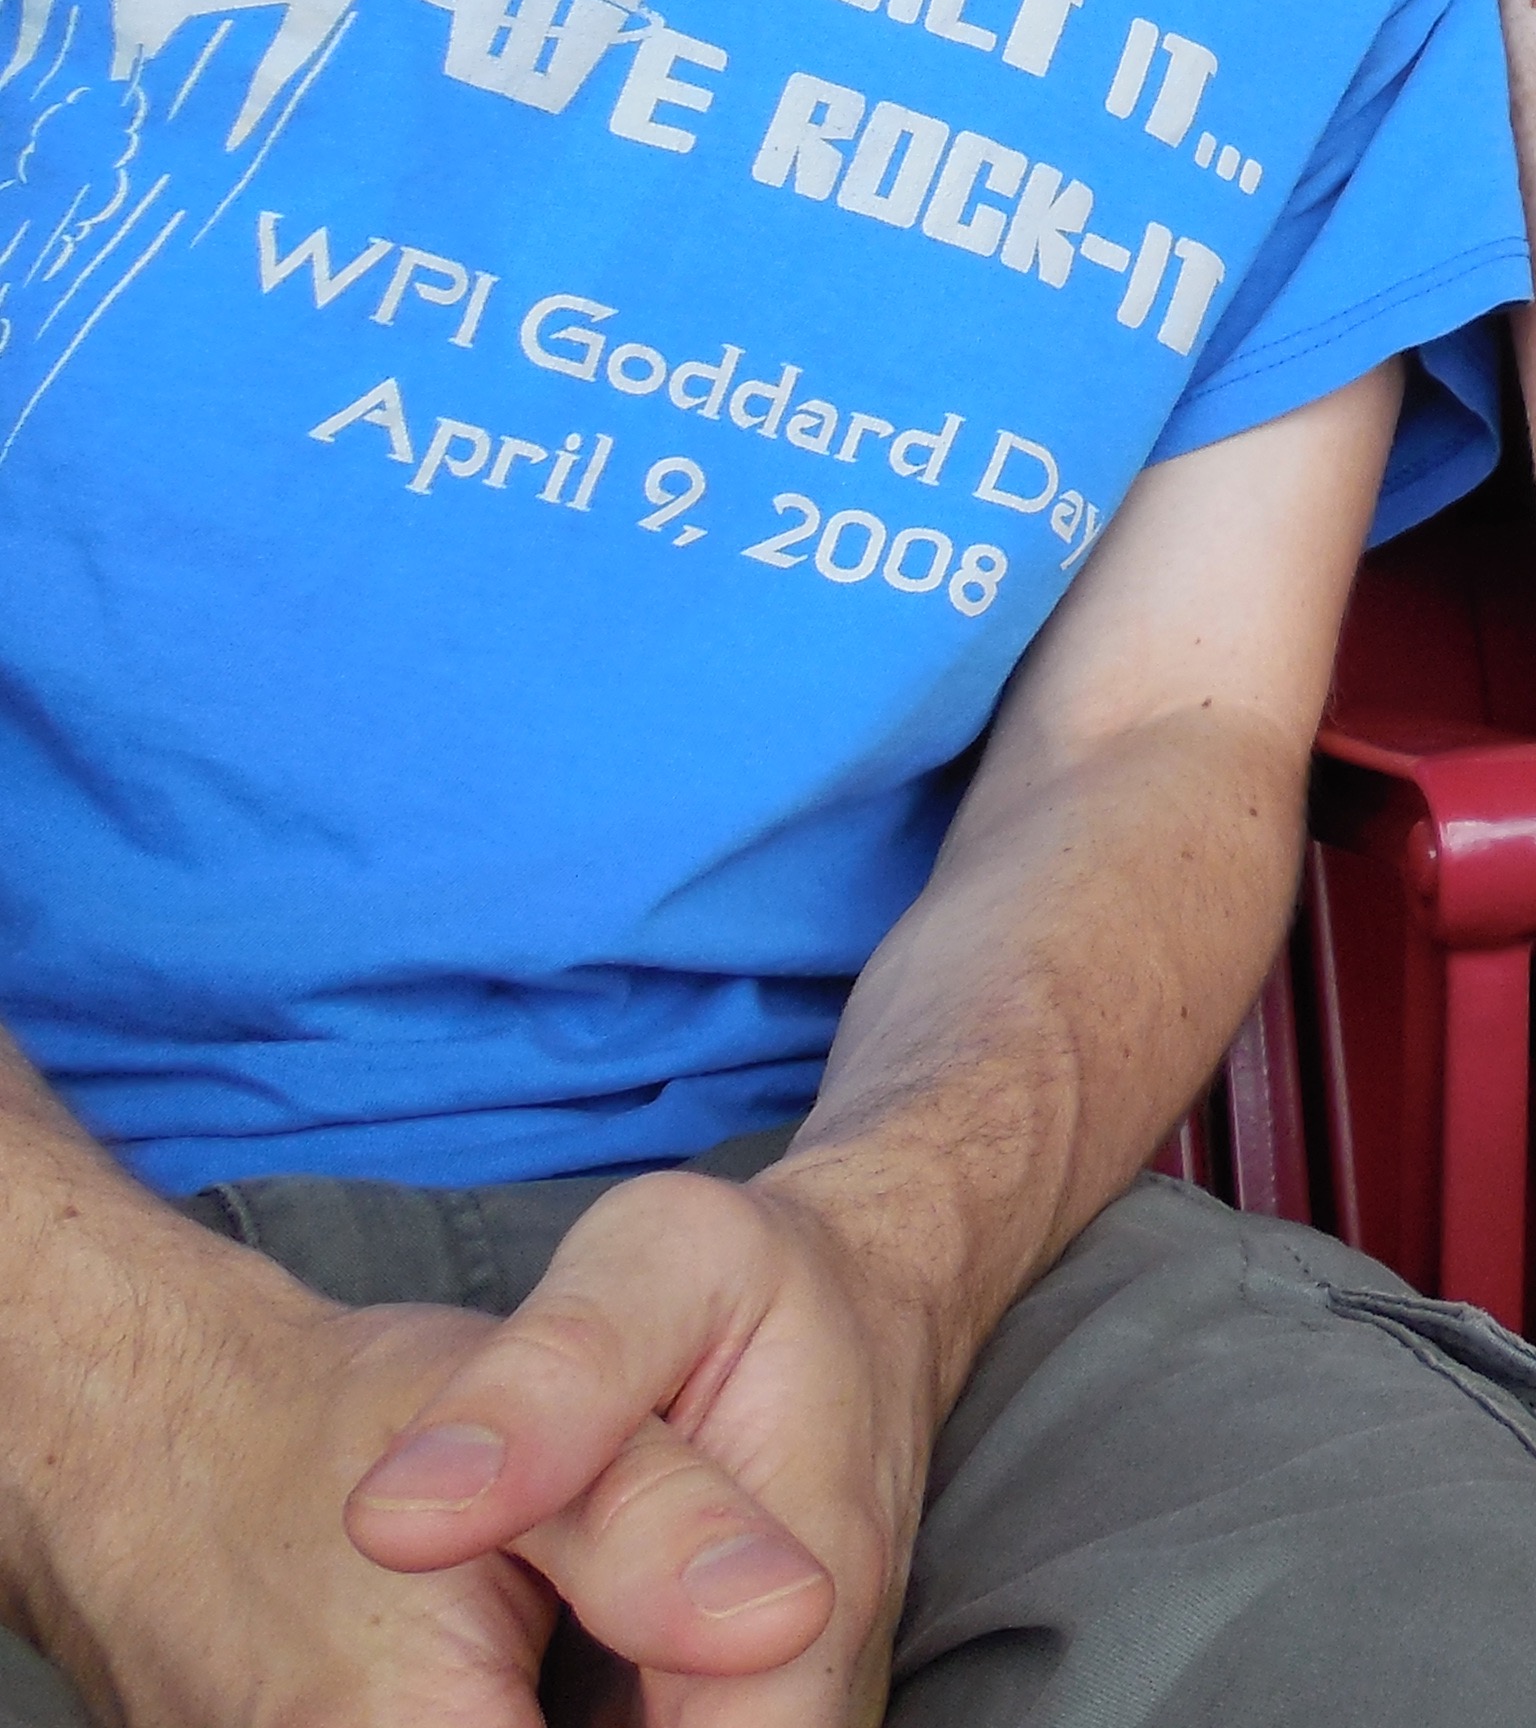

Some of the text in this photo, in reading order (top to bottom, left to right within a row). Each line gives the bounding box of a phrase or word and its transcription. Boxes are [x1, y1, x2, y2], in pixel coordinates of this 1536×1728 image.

[751, 72, 1225, 356] ROCK-IT
[258, 211, 1101, 570] WPI Goddard Day
[309, 378, 1008, 617] April 9, 2008
